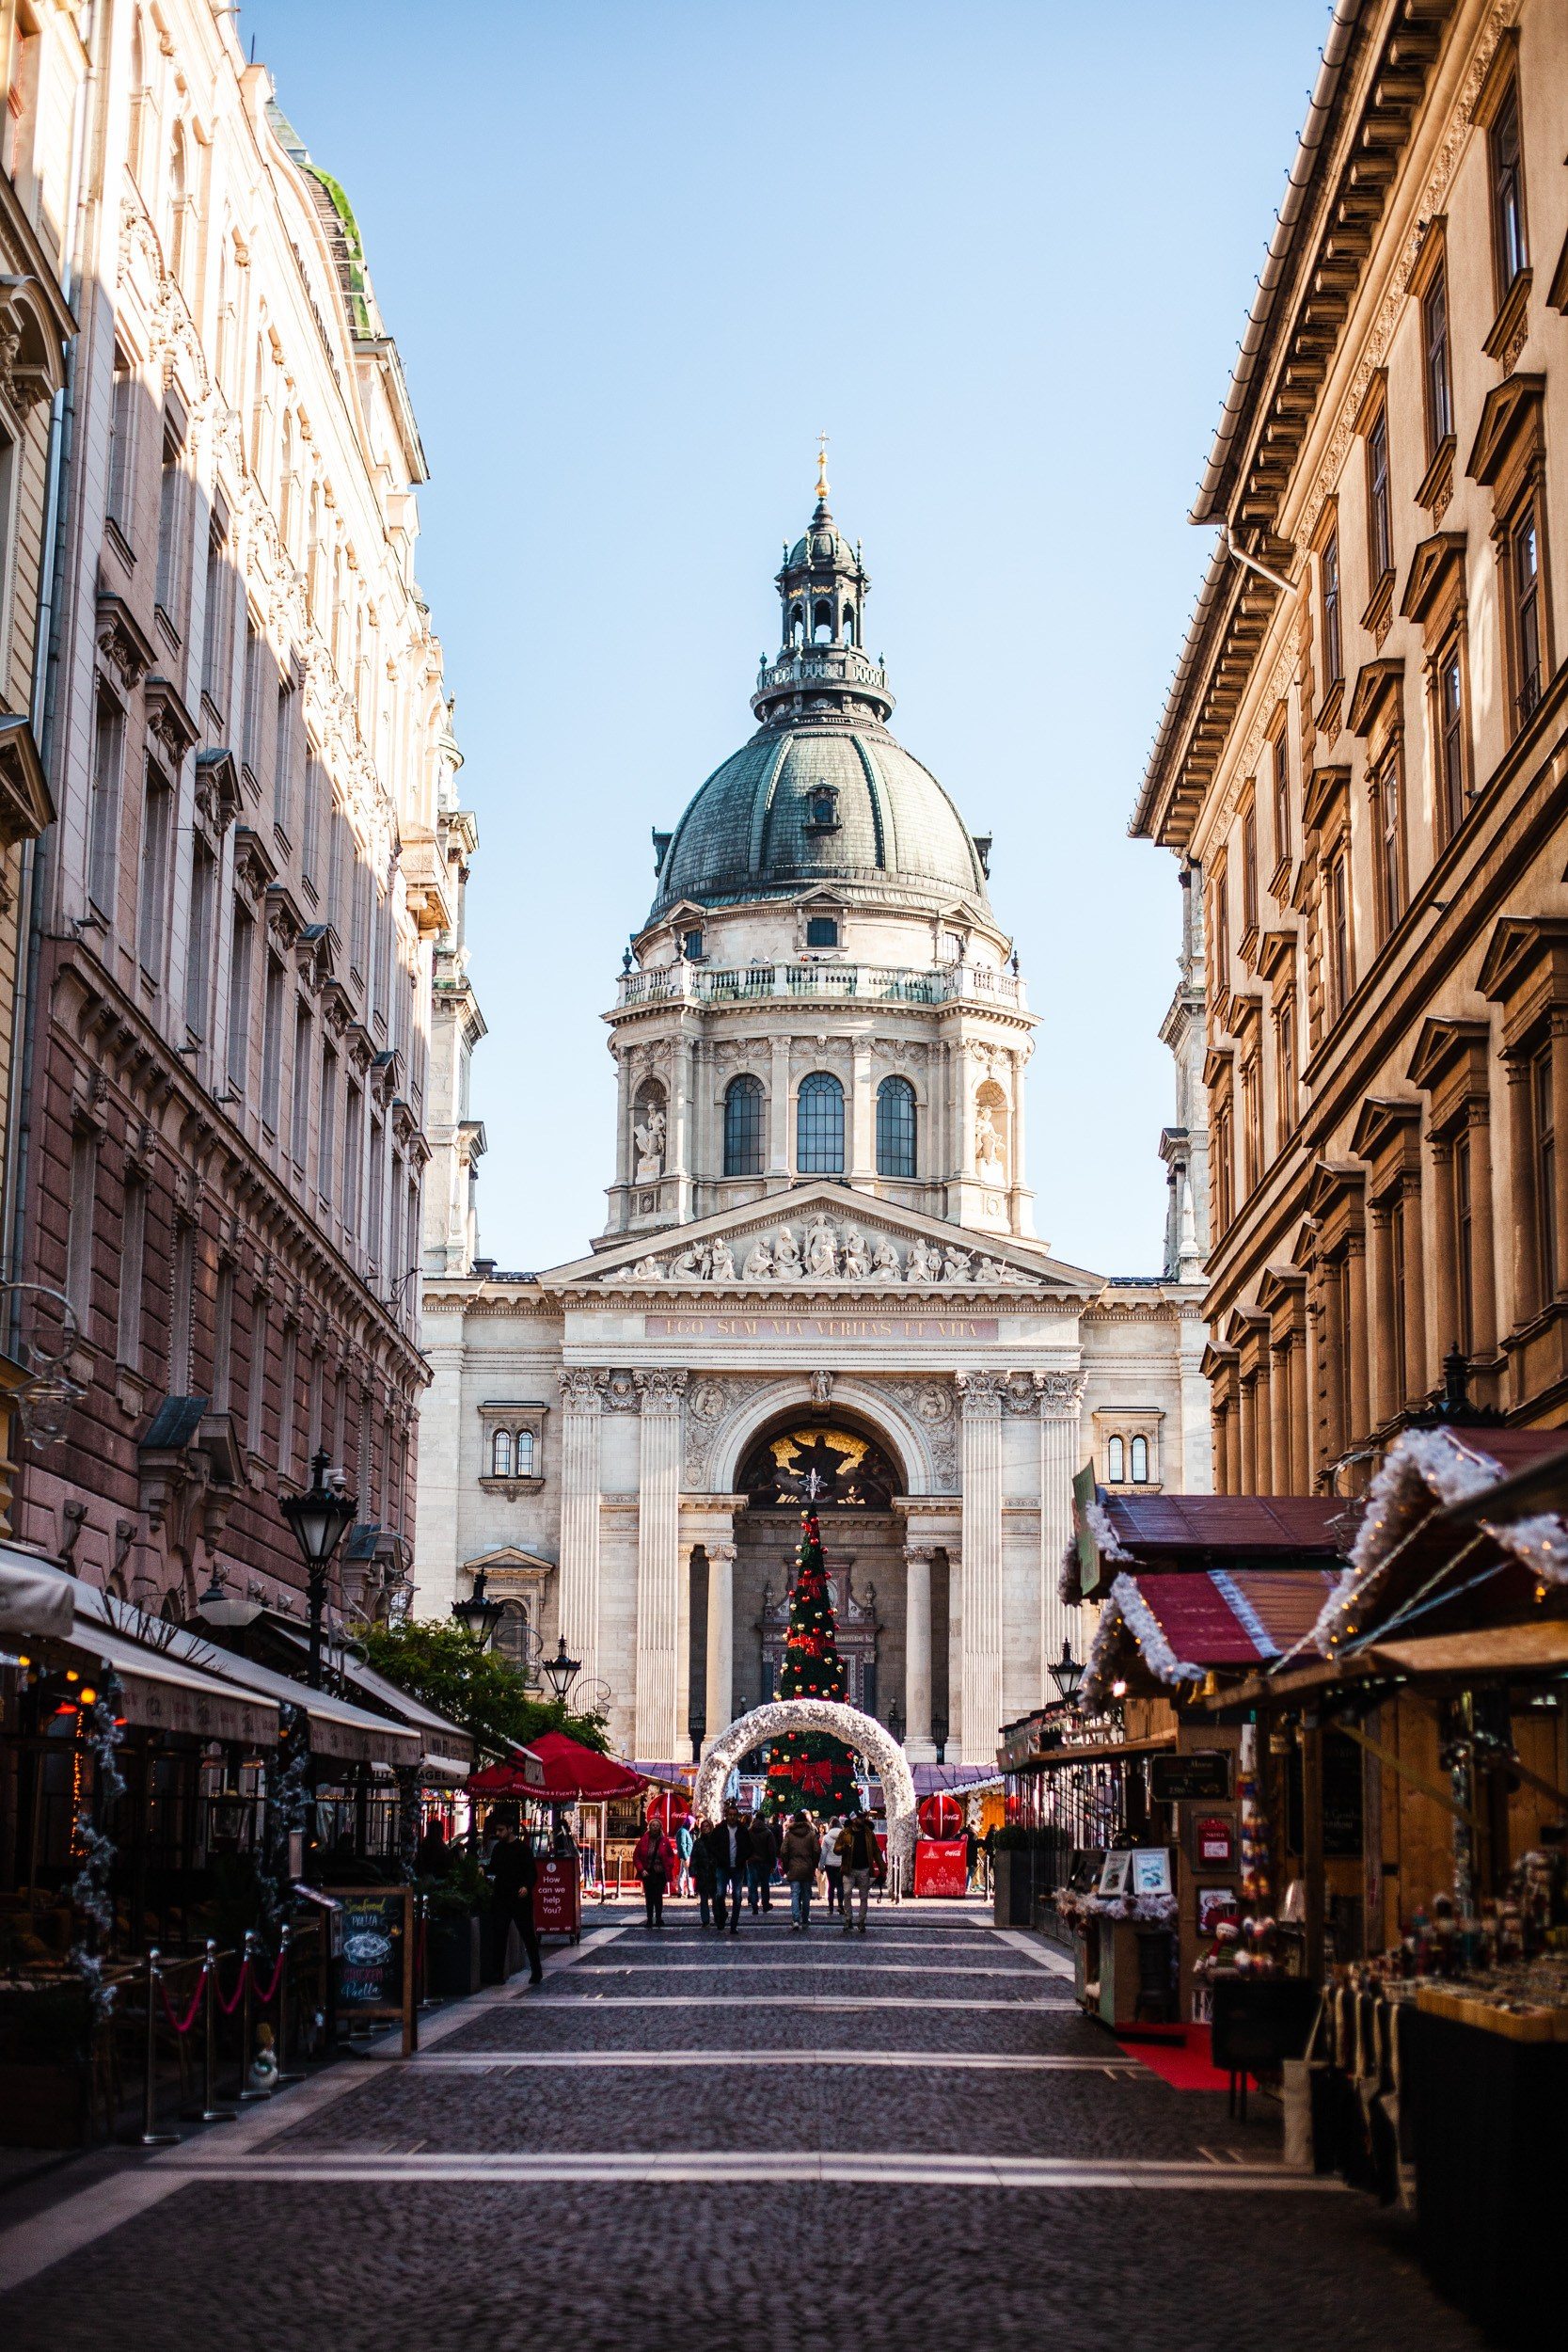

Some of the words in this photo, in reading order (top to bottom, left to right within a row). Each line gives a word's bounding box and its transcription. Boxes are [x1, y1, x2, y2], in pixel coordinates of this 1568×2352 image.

[666, 1320, 704, 1335] EGO
[717, 1320, 757, 1335] SUM
[771, 1321, 804, 1336] VIA
[816, 1321, 892, 1336] VERITAS
[904, 1322, 926, 1337] ET
[938, 1322, 977, 1337] VITA
[418, 1771, 449, 1780] AGEL
[513, 1784, 550, 1796] PROGRAMMES
[603, 1786, 635, 1795] INFORMATION
[543, 1897, 561, 1905] help
[341, 1980, 380, 1998] Paella
